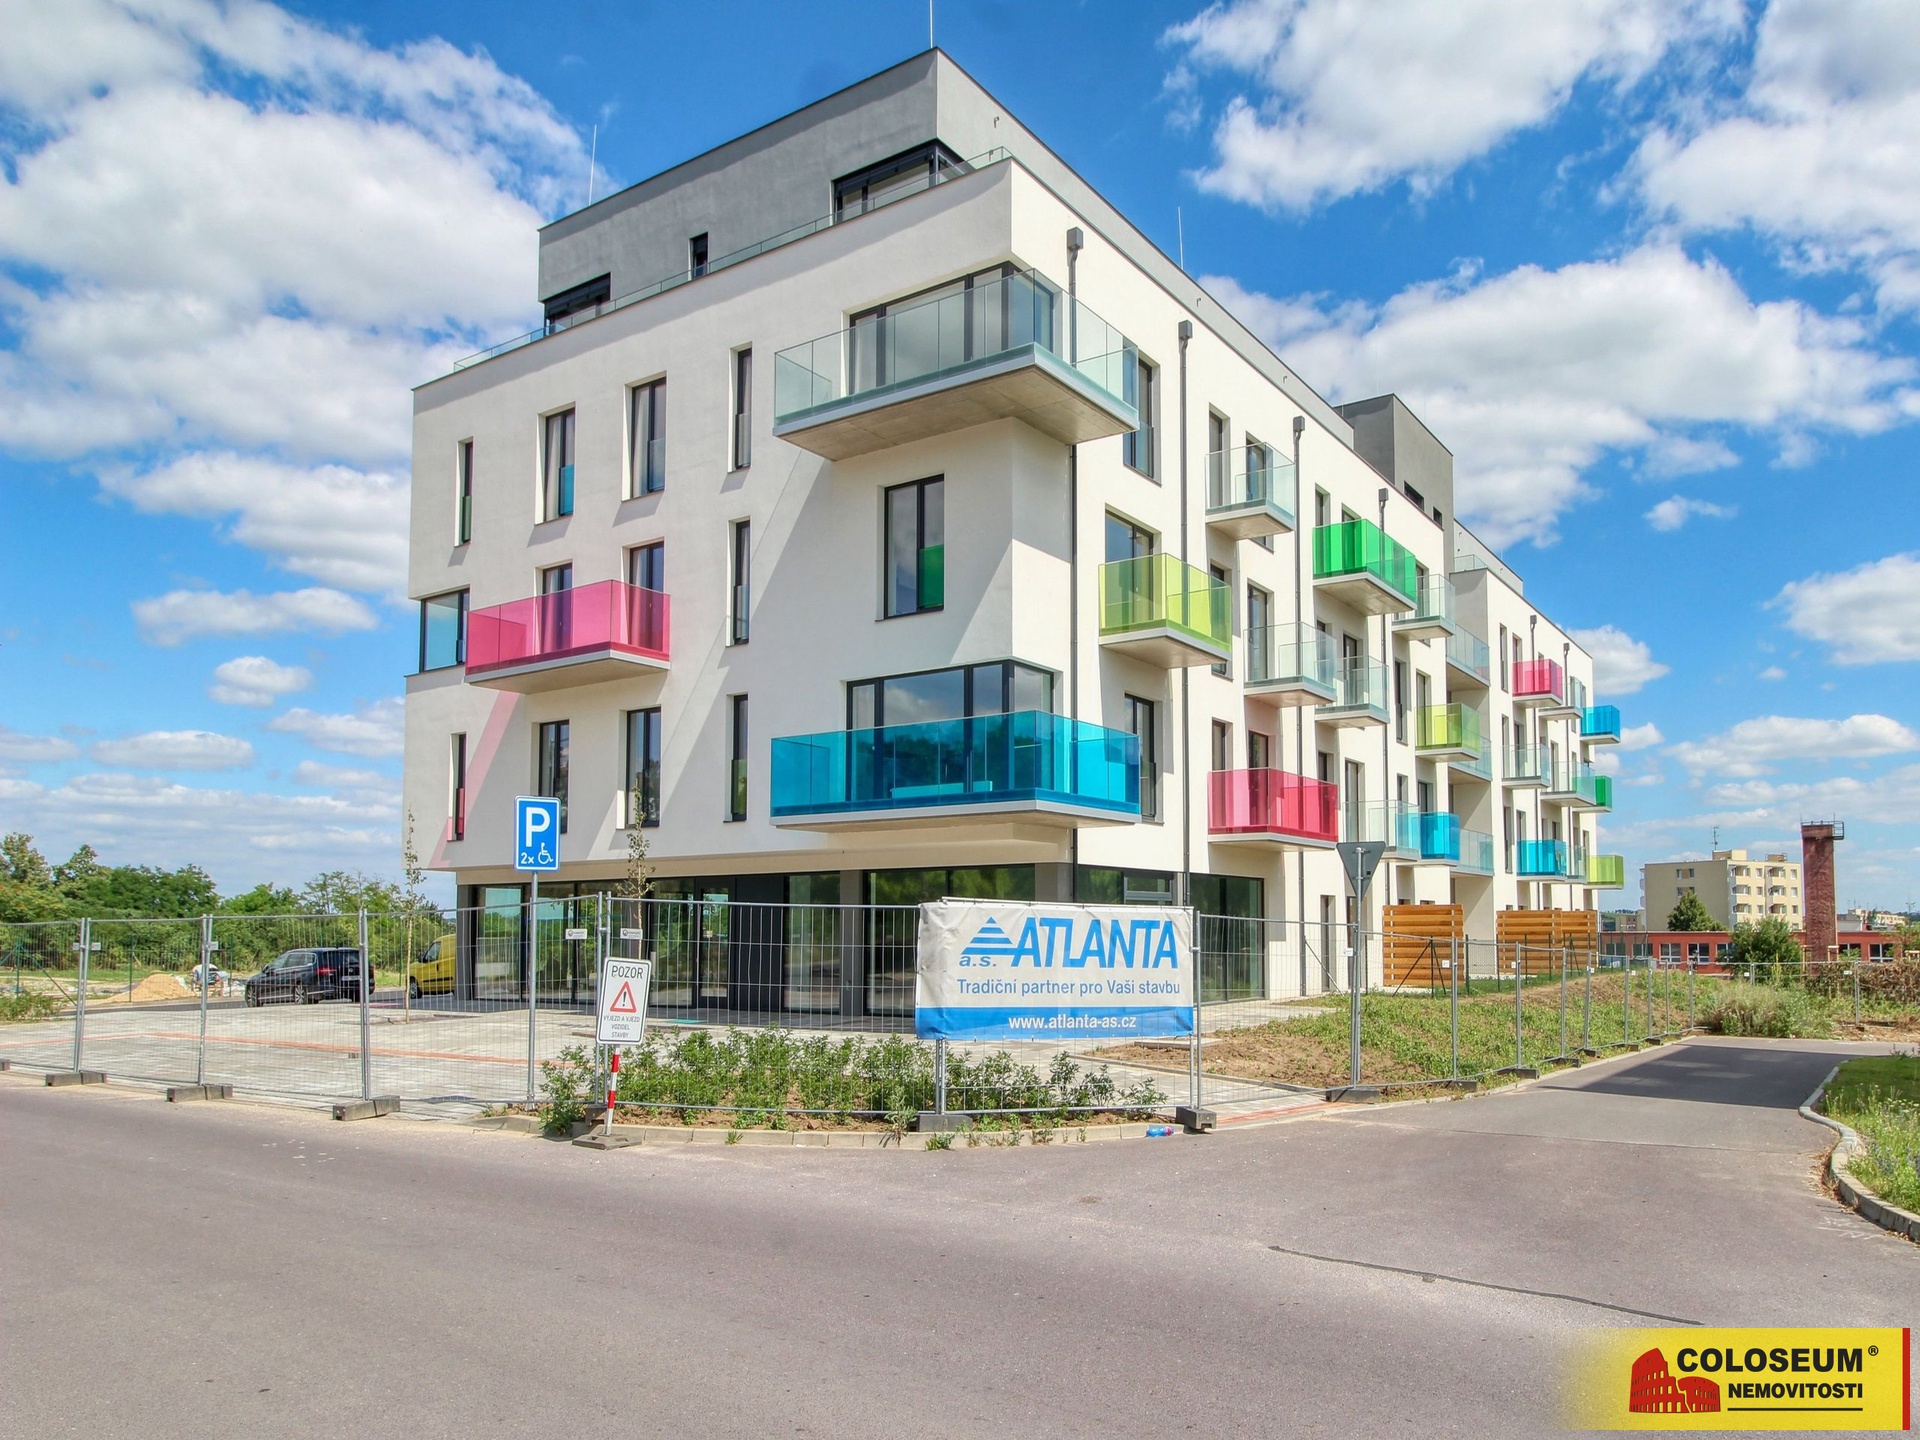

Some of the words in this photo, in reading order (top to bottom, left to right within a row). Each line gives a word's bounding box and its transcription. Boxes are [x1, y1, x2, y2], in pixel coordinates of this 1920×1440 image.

[525, 806, 549, 848] P
[520, 852, 535, 865] 2x
[1011, 917, 1178, 969] ATLANTA
[958, 955, 997, 967] a.s.
[611, 965, 643, 979] POZOR
[957, 979, 1017, 994] Tradiční
[1021, 981, 1075, 997] partner
[1079, 982, 1103, 997] pro
[1107, 980, 1135, 994] Vaši
[1139, 980, 1180, 994] stavbu
[1008, 1014, 1137, 1029] www.atlanta-as.cz
